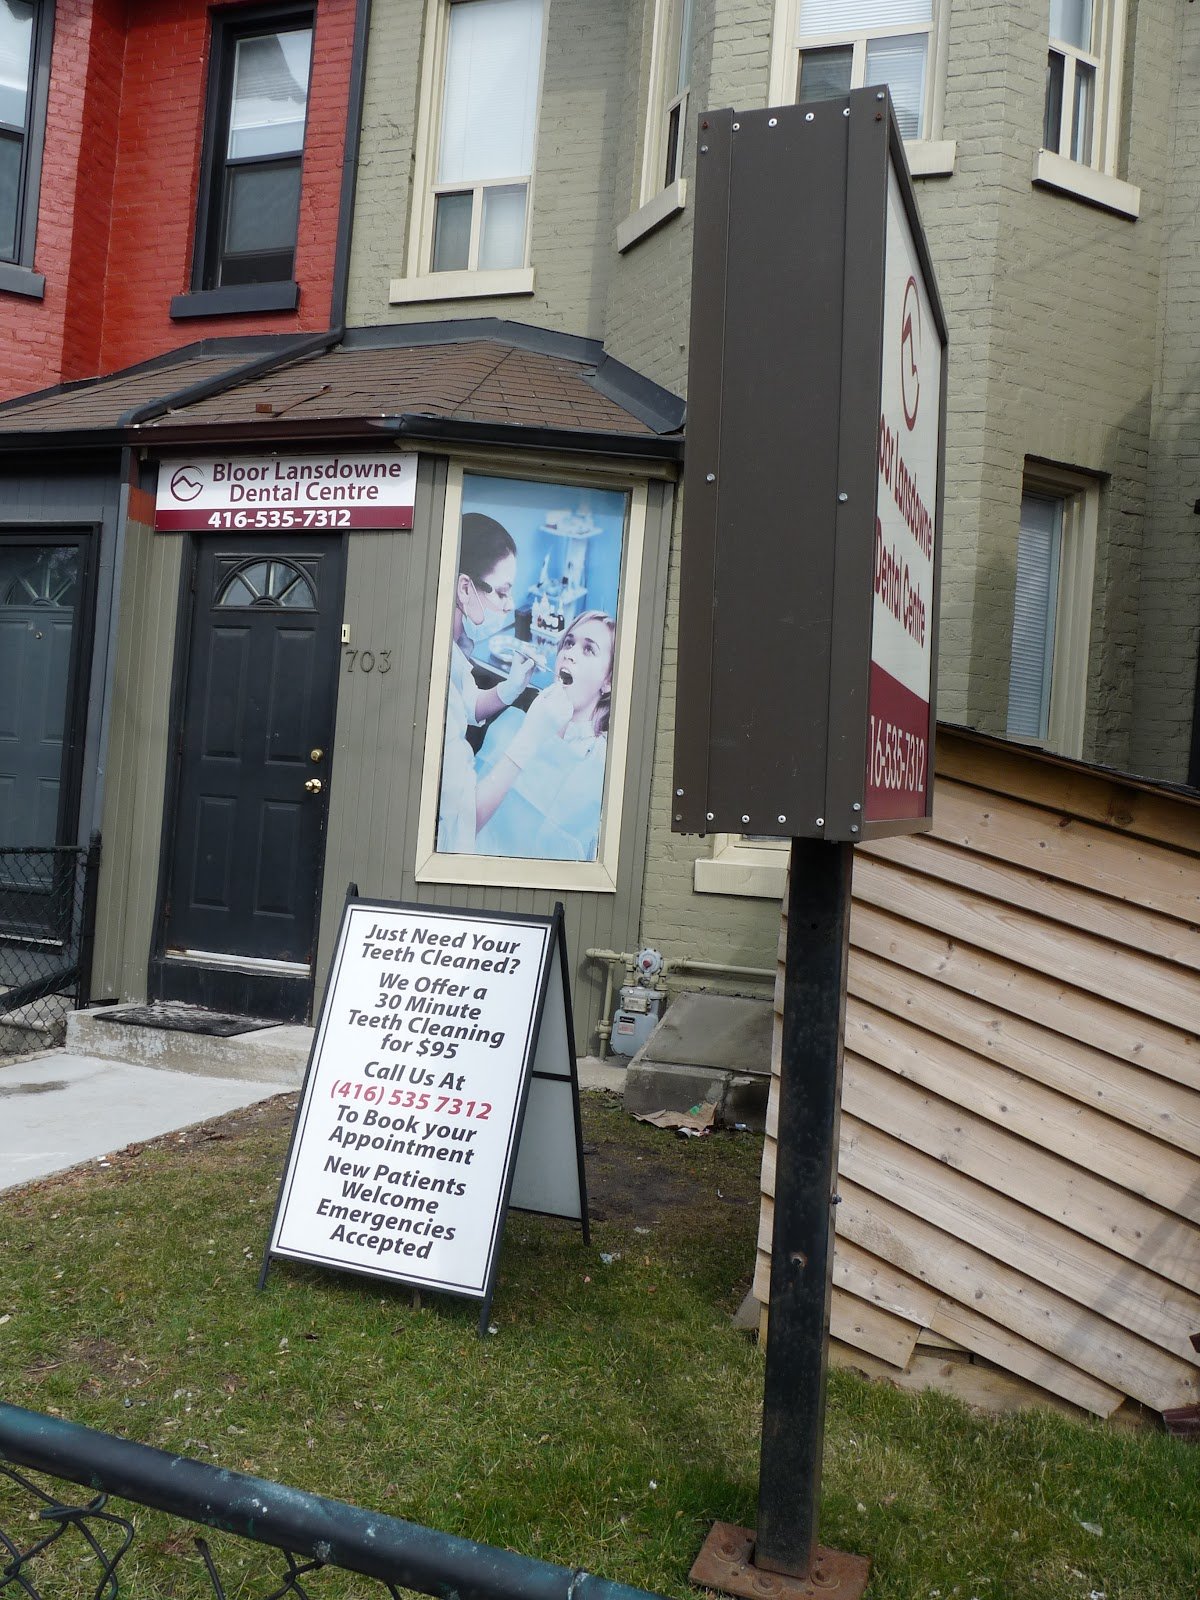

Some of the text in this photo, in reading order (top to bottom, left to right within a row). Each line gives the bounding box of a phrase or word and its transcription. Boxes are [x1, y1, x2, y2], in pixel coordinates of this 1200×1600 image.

[213, 459, 401, 482] Bloor Lansdowne
[230, 481, 379, 502] Dental Centre
[894, 430, 932, 562] Lansdowne
[208, 510, 351, 528] 416-535-7312
[874, 516, 926, 649] Dental Centre
[345, 650, 392, 674] 703
[867, 714, 925, 792] 16-535-7312
[365, 924, 521, 954] Just Need Your
[362, 943, 521, 975] Teeth Cleaned?
[379, 972, 488, 1000] We Offer a
[375, 993, 481, 1020] 30 Minute
[349, 1009, 505, 1049] Teeth Cleaning
[381, 1033, 459, 1059] for $95
[364, 1061, 466, 1091] Call Us At
[331, 1080, 492, 1120] (416) 535 7312
[337, 1104, 477, 1142] To Book your
[328, 1126, 475, 1165] Appointment
[324, 1155, 466, 1196] New Patients
[342, 1180, 439, 1214] Welcome
[316, 1198, 456, 1240] Emergencies
[329, 1224, 433, 1259] Accepted
